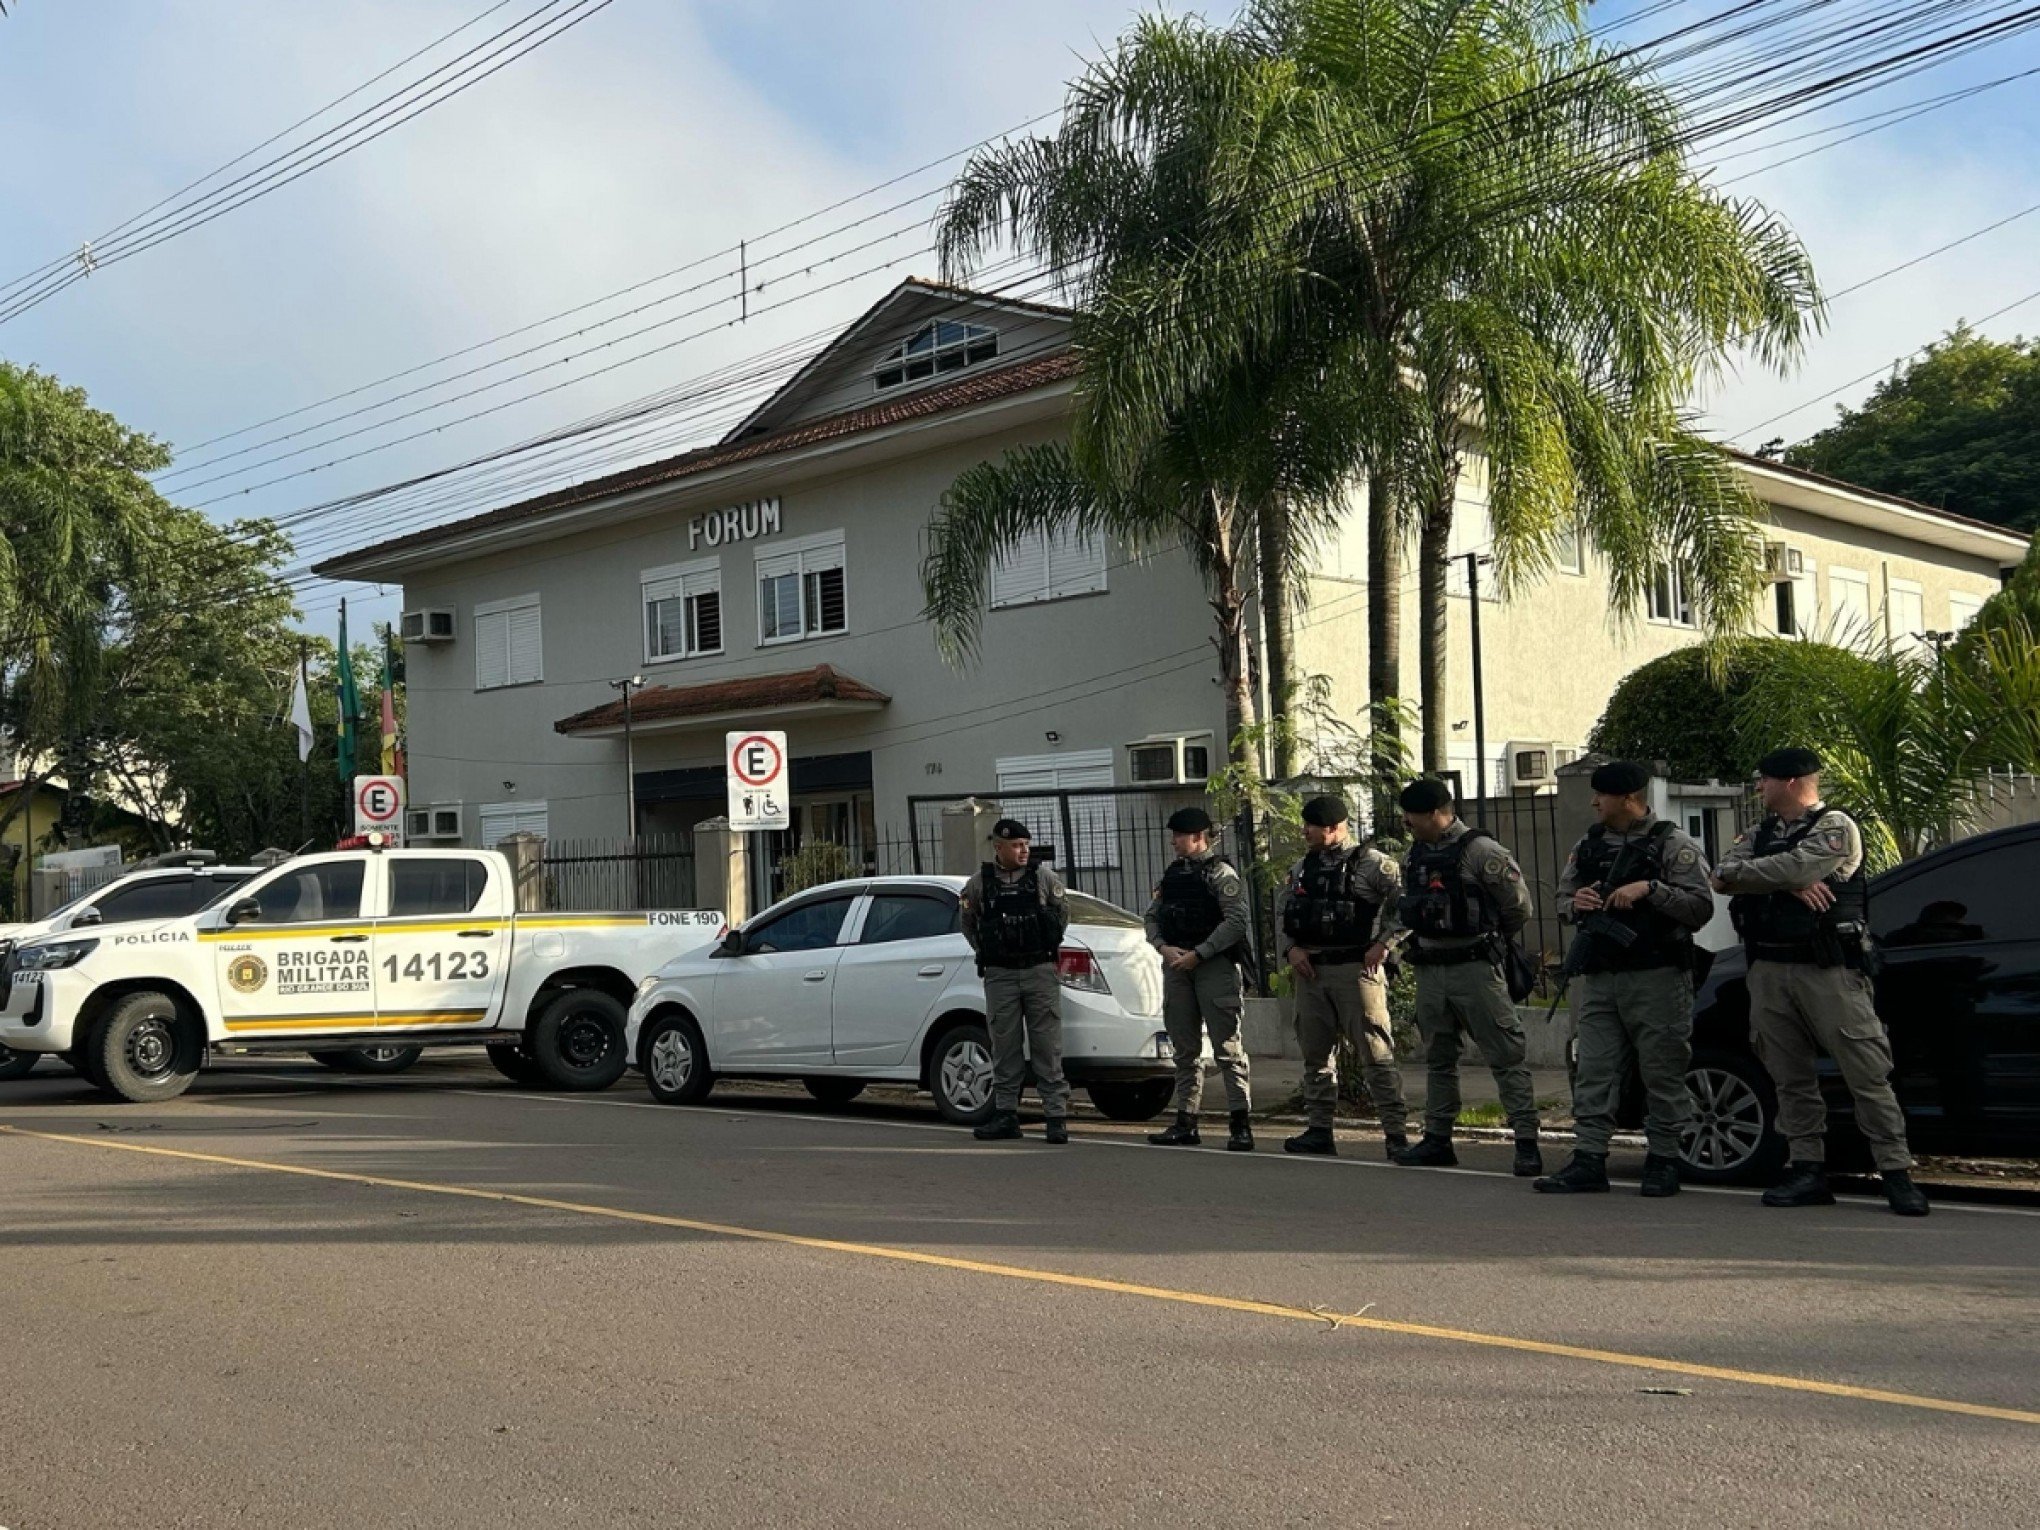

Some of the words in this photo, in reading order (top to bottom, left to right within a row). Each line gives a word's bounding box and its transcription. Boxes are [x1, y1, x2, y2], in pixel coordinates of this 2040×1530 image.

[687, 496, 783, 550] FORUM
[747, 747, 765, 775] E
[371, 790, 386, 812] E
[648, 912, 691, 925] FONE
[693, 912, 719, 925] 190
[277, 950, 369, 966] BRIGADA
[383, 951, 489, 983] 14123
[13, 971, 45, 984] 14123
[278, 966, 369, 983] MILITAR
